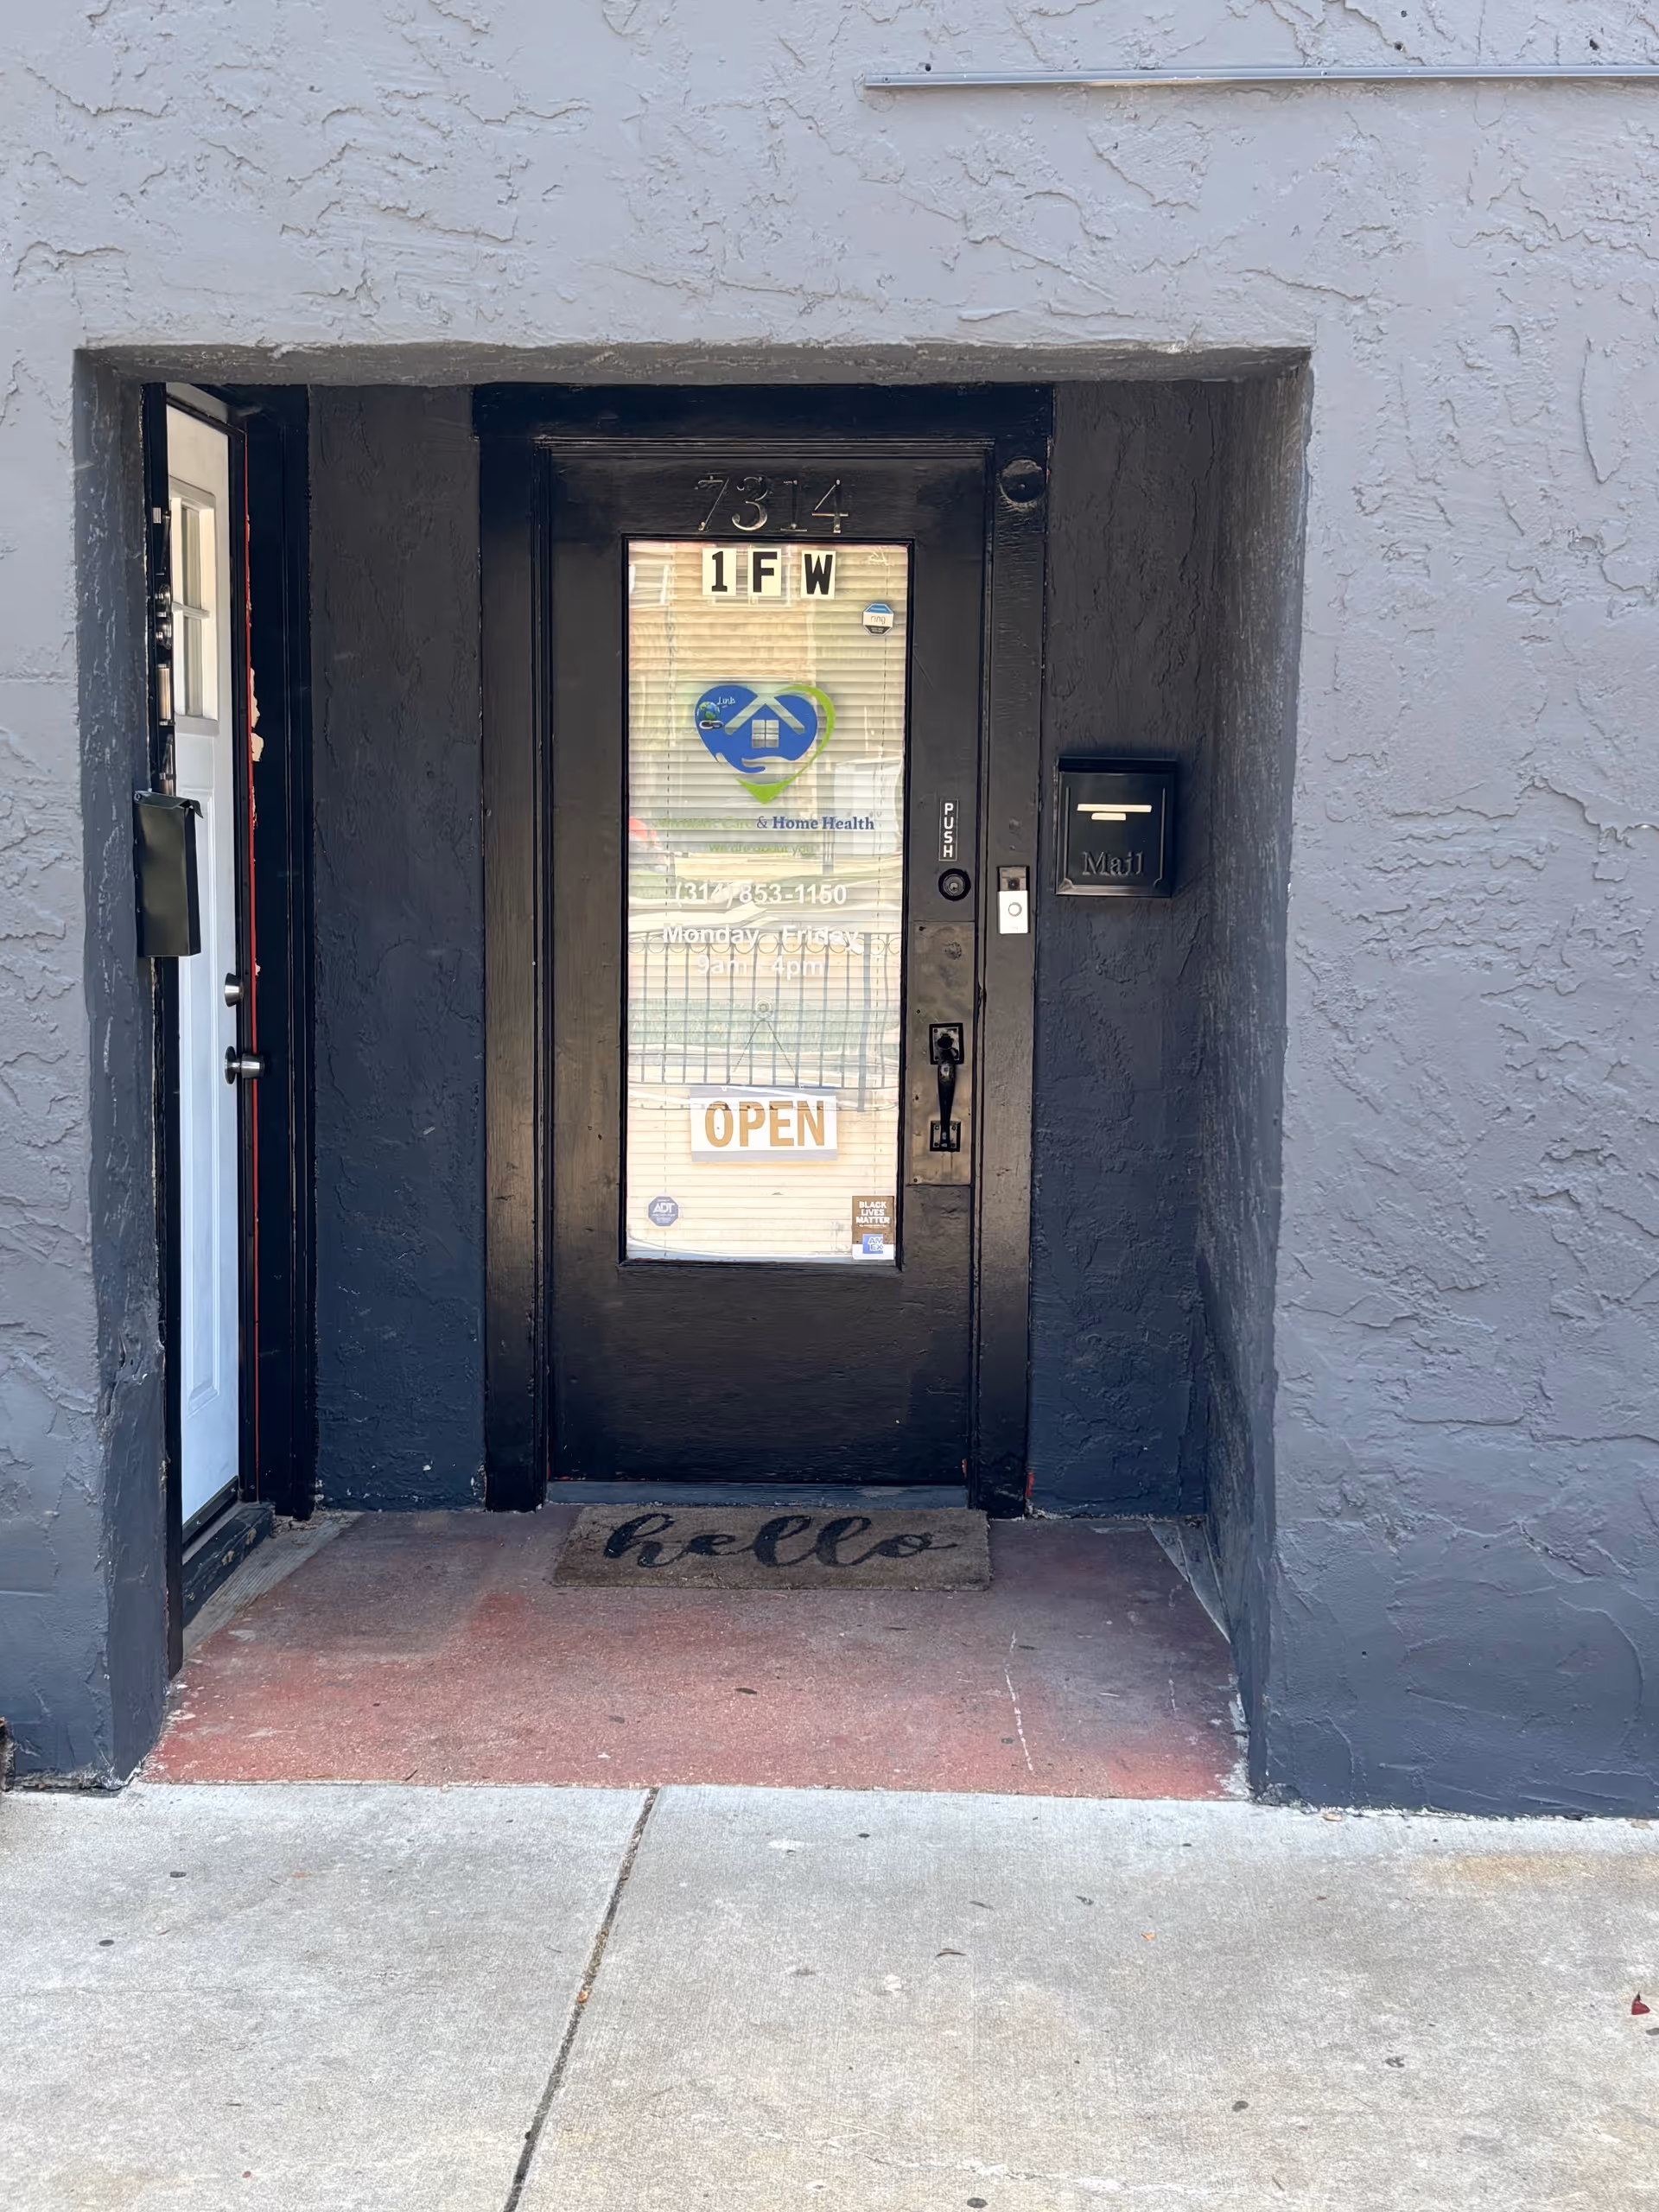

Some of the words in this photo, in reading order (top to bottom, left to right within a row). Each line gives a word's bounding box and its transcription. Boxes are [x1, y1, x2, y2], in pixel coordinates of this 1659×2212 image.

[694, 475, 849, 533] 7314
[711, 551, 728, 593] 1
[753, 551, 778, 593] F
[804, 554, 834, 595] W
[870, 615, 887, 625] ring
[757, 816, 768, 829] &
[772, 817, 818, 830] Home
[822, 817, 874, 830] Health
[943, 803, 954, 858] PUSH
[1082, 850, 1145, 876] Mail
[664, 925, 760, 950] Monday
[782, 925, 859, 950] Friday
[697, 954, 747, 976] 9am
[771, 955, 824, 980] 4pm
[704, 1100, 825, 1147] OPEN
[652, 1202, 675, 1213] ADT
[606, 1513, 957, 1567] hello
